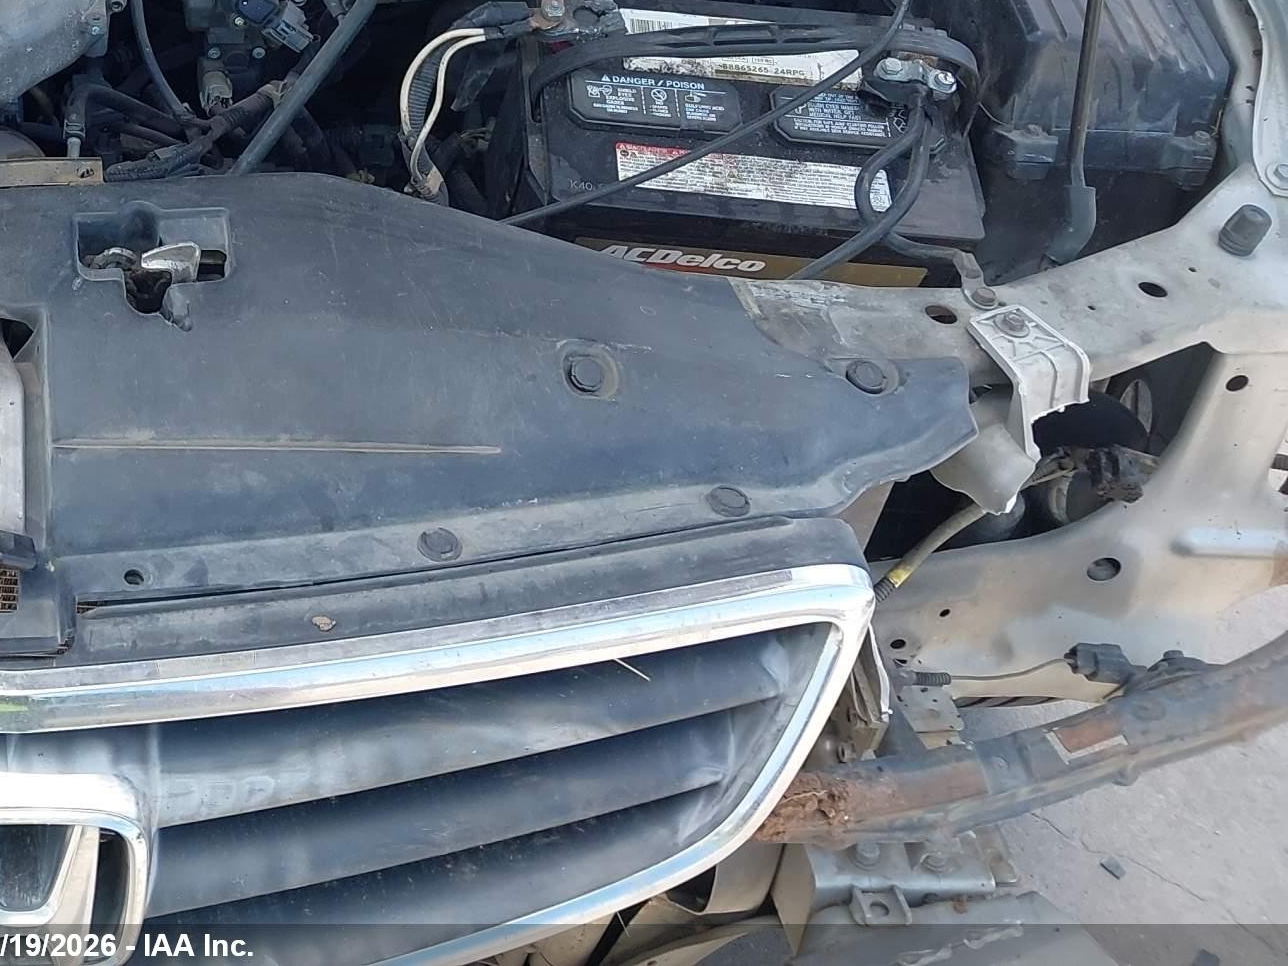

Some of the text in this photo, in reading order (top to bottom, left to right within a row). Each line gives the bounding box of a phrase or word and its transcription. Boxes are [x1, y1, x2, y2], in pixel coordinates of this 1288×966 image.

[612, 76, 655, 86] DANGER
[666, 80, 705, 90] POISON
[600, 245, 766, 272] ACDelco
